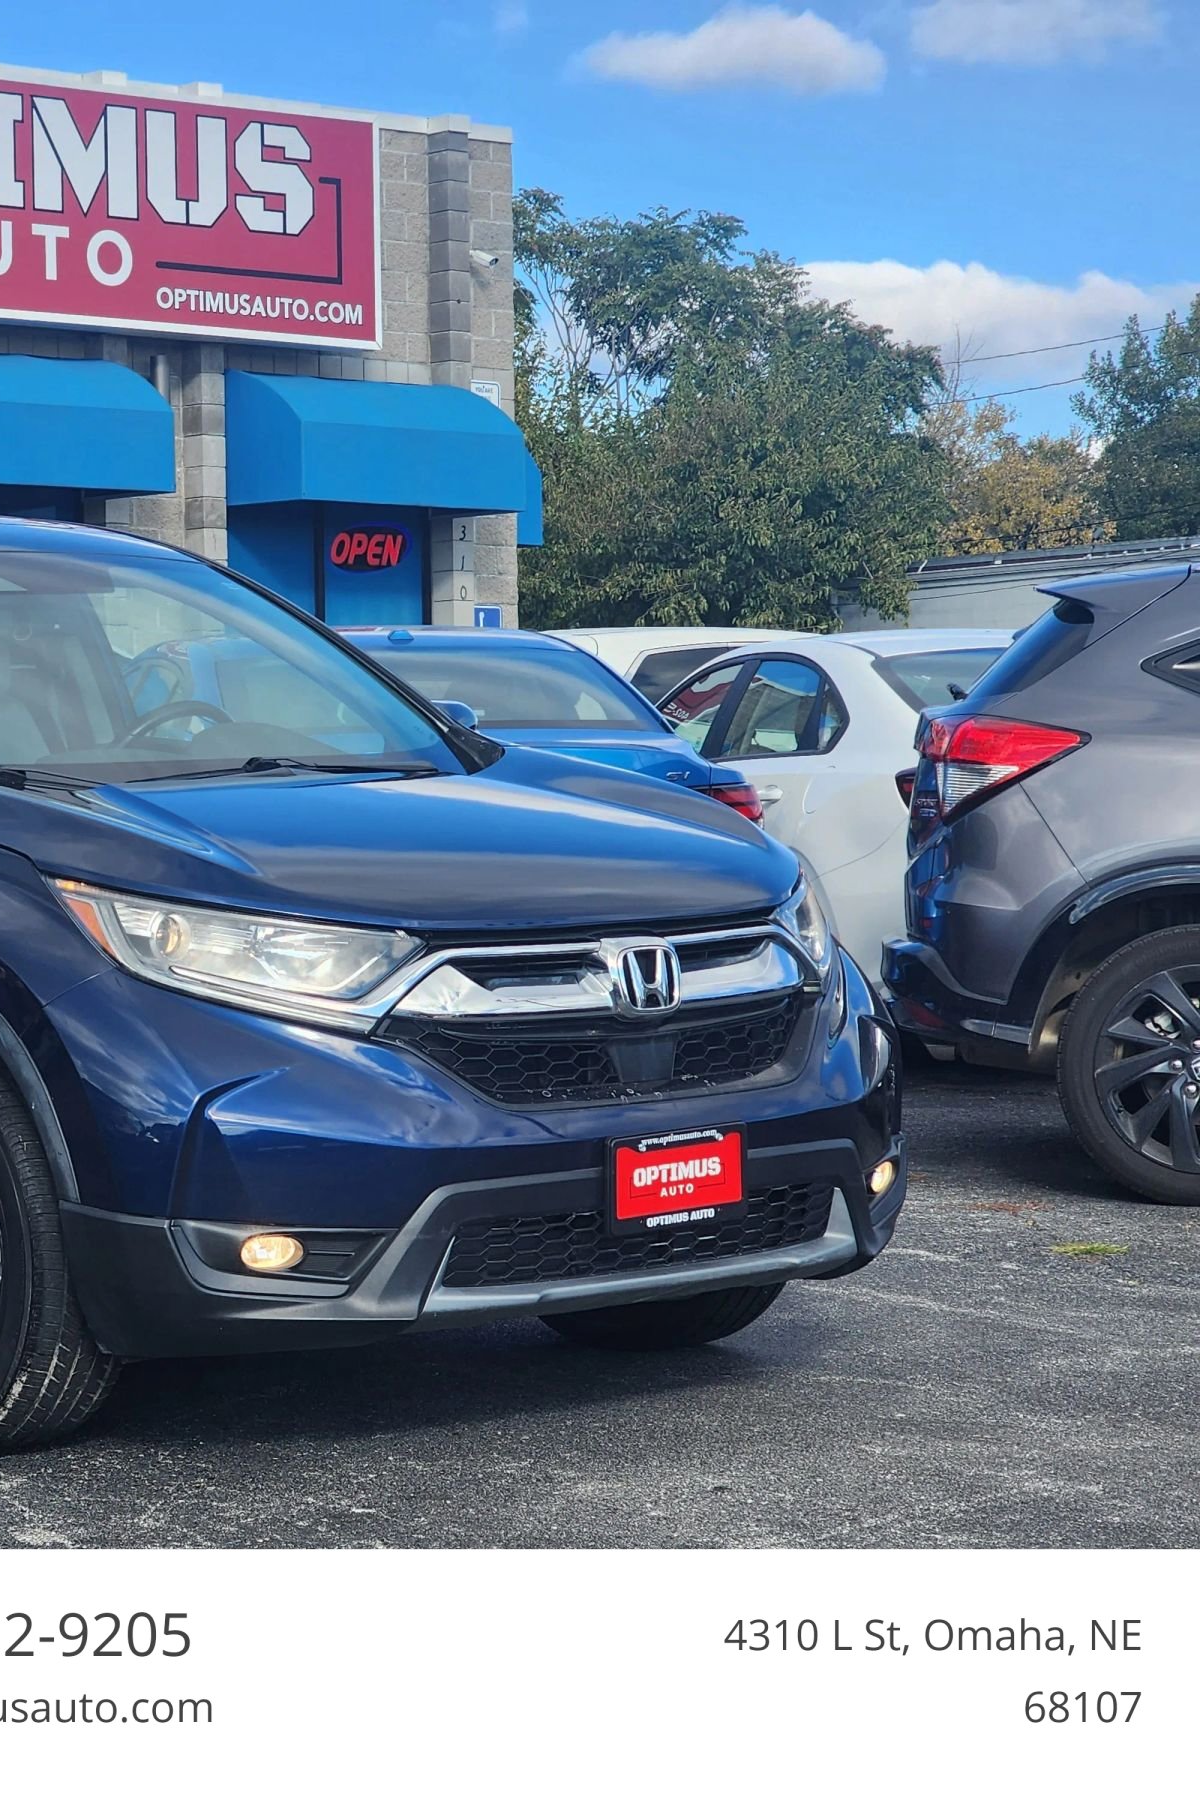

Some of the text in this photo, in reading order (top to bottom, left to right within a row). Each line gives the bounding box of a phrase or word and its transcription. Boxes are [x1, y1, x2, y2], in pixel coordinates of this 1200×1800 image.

[156, 286, 364, 326] OPTIMUSAUTO.COM
[330, 532, 404, 567] OPEN
[633, 1156, 722, 1188] OPTIMUS
[660, 1183, 695, 1198] AUTO
[646, 1207, 715, 1228] OPTIMUS AUTO
